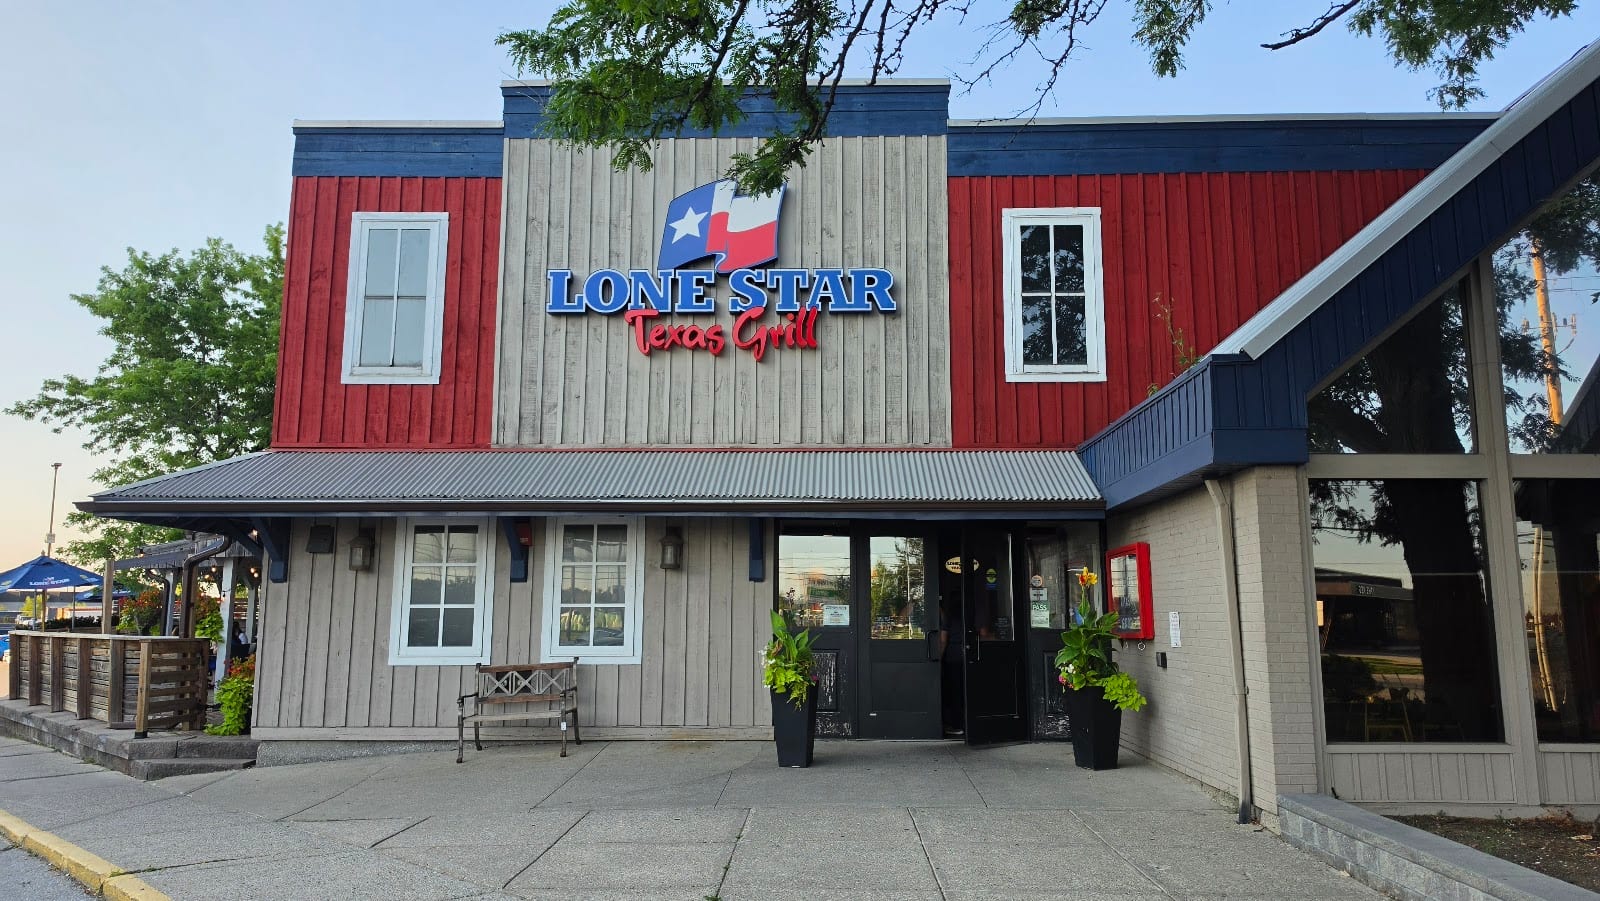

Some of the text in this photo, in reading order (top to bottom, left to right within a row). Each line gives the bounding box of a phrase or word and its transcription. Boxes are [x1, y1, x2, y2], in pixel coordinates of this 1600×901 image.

[546, 267, 897, 314] LONE STAR
[624, 306, 818, 361] Texas Grill
